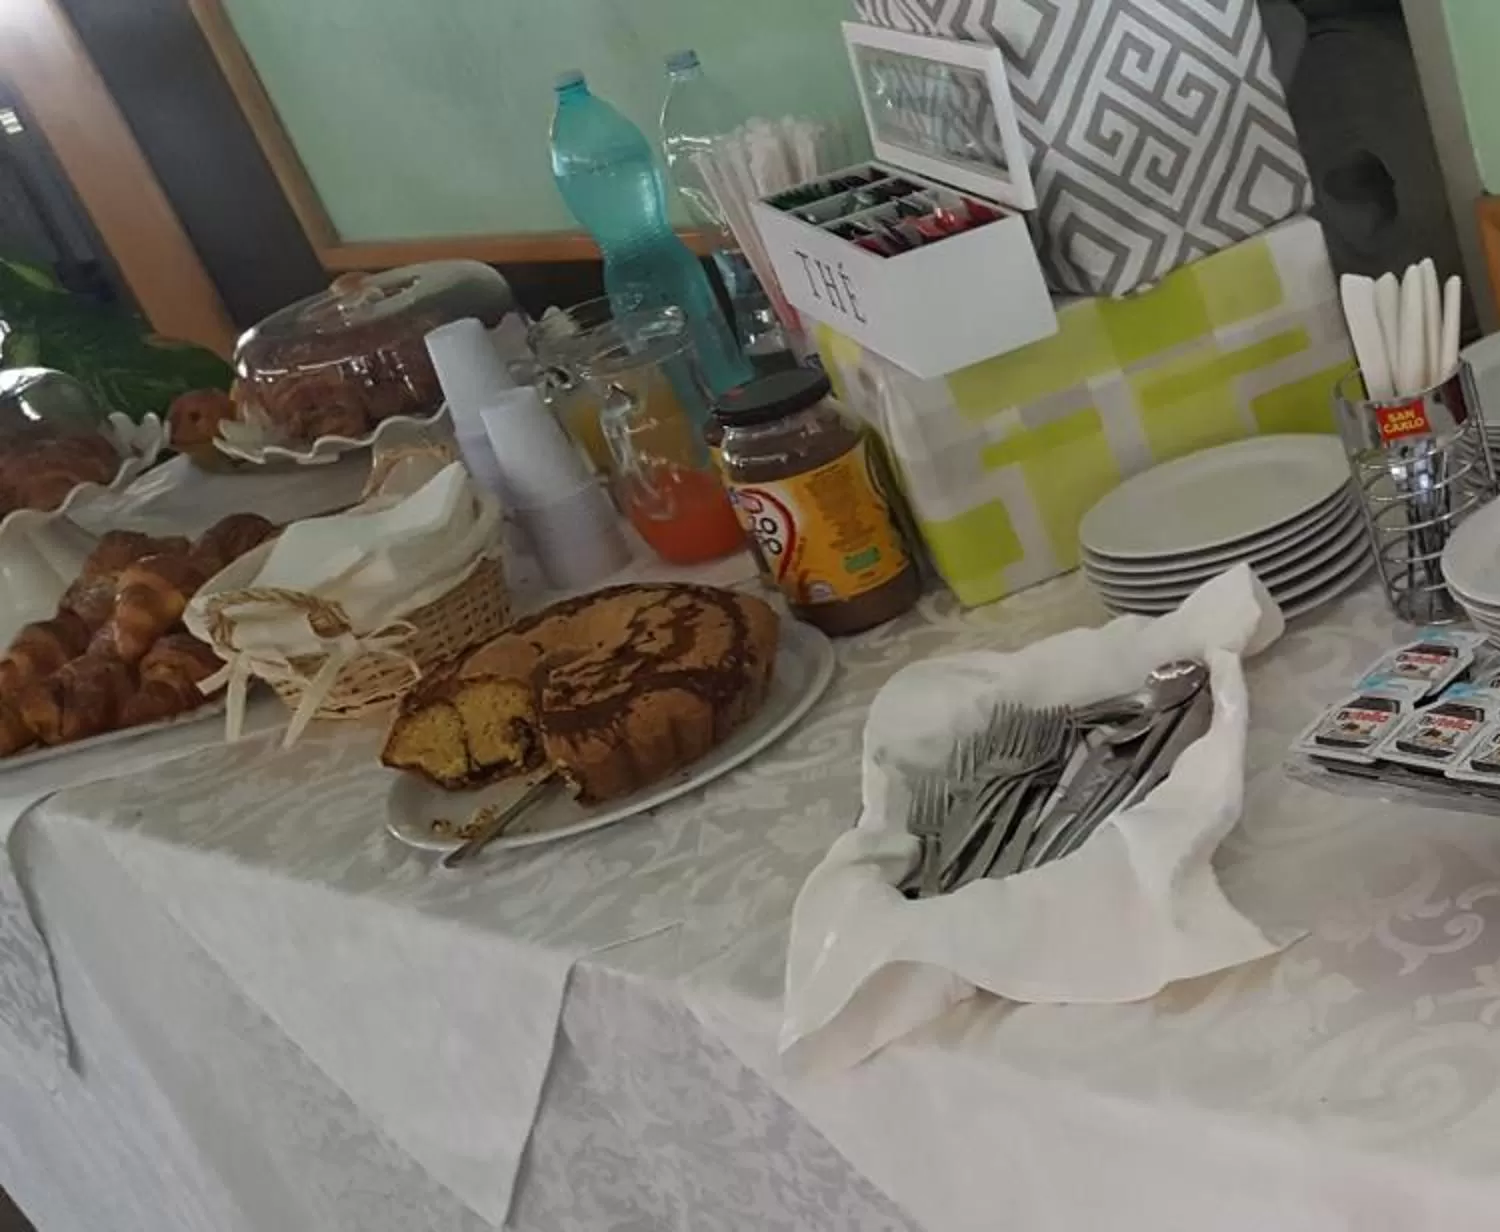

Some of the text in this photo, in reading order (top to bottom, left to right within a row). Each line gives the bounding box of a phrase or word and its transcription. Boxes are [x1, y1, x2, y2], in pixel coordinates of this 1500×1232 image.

[1387, 409, 1415, 422] SAN
[1383, 417, 1425, 435] CARLO
[1336, 710, 1390, 724] nutella
